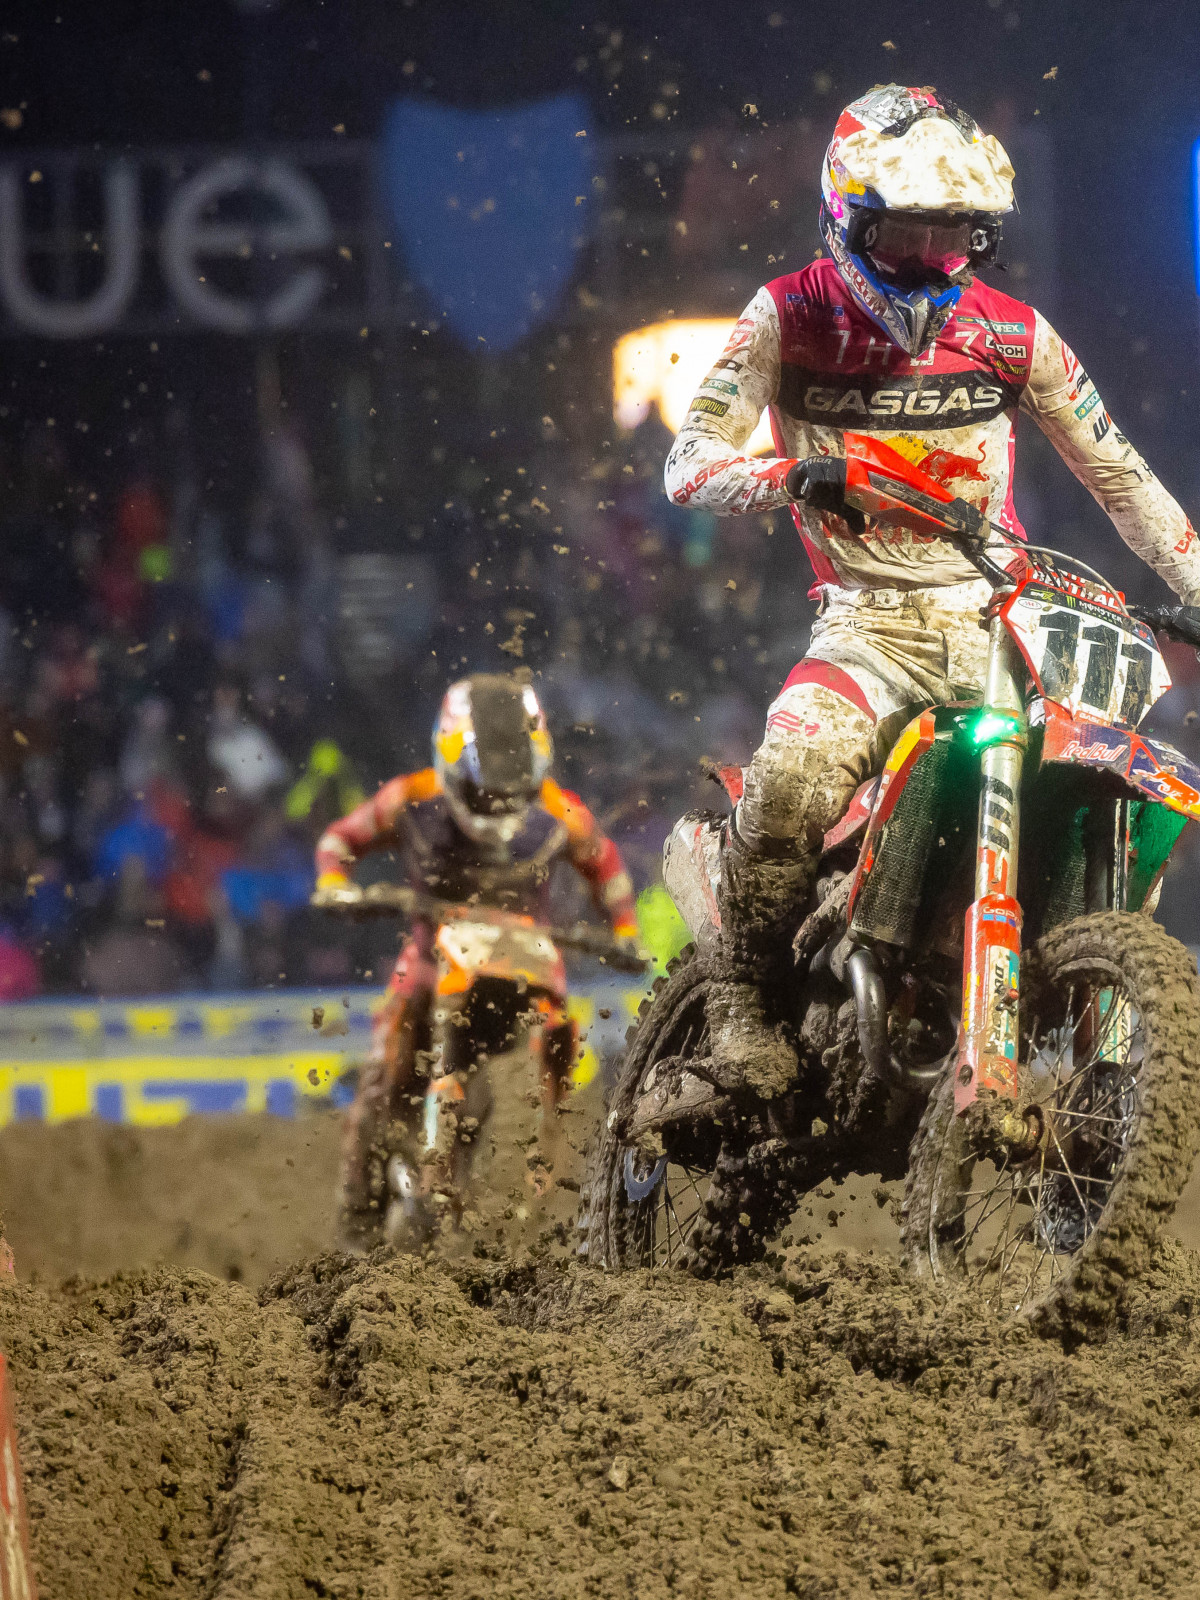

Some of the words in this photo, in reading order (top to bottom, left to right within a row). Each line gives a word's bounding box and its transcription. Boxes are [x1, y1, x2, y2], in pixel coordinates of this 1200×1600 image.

[803, 384, 1003, 416] GASGAS
[672, 455, 750, 504] GASGA
[1038, 609, 1153, 731] 111
